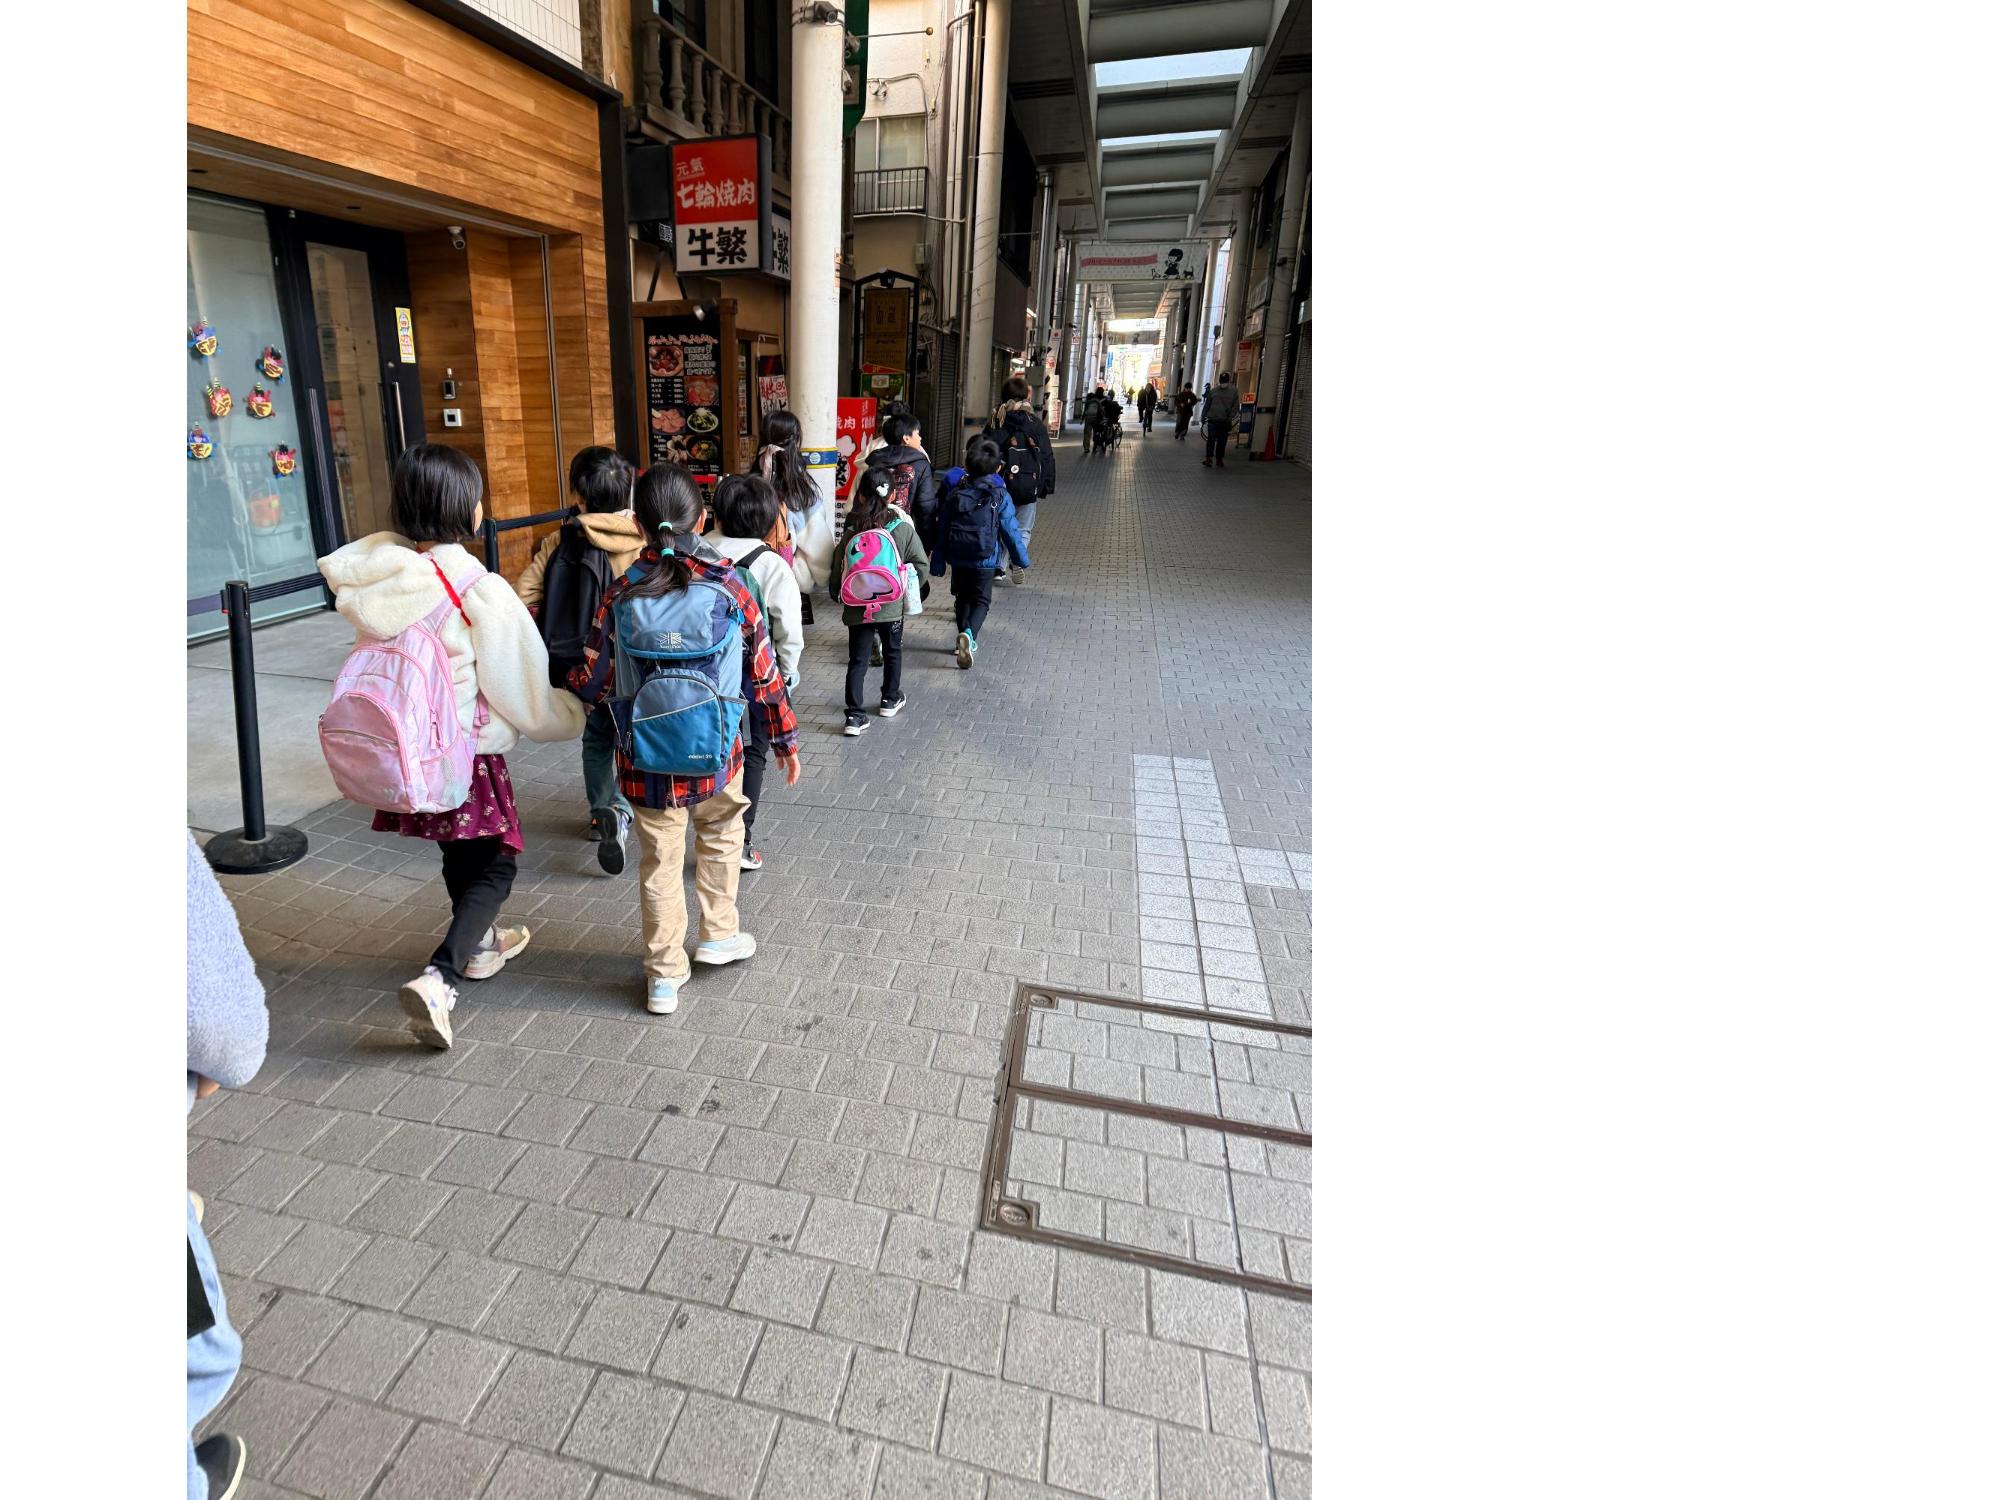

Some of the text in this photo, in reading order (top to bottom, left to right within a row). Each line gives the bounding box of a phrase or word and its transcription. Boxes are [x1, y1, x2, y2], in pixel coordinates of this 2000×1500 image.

[677, 178, 755, 209] 七輪焼肉
[687, 226, 748, 266] 牛繁
